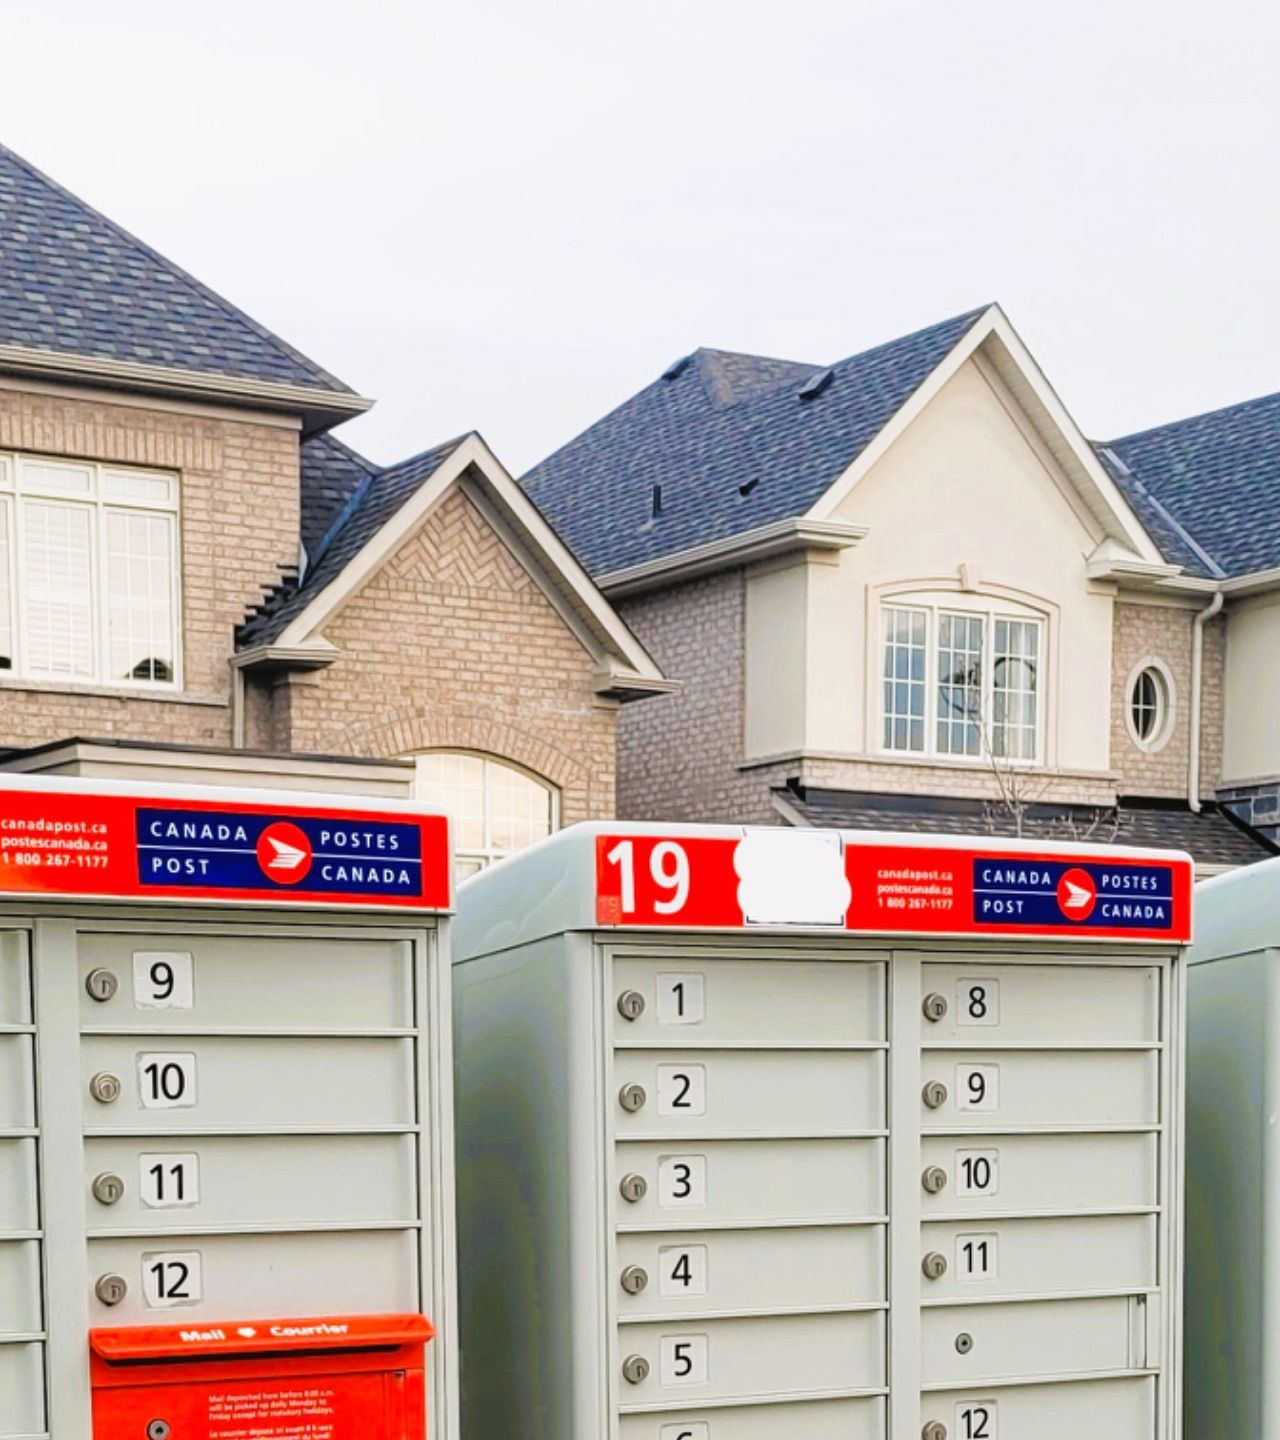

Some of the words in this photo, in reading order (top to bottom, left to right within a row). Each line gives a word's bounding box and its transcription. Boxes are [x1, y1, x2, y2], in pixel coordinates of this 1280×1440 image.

[1, 818, 108, 835] canadapost.ca
[150, 821, 248, 842] CANADA
[320, 831, 400, 850] POSTES
[1, 836, 108, 851] postescanada.ca
[15, 853, 40, 866] 800
[46, 854, 108, 868] 267-1177
[152, 858, 210, 875] POST
[321, 865, 411, 884] CANADA
[877, 869, 953, 881] canadapost.ca
[607, 840, 690, 914] 19
[877, 884, 953, 896] postescanada.ca
[982, 870, 1052, 885] CANADA
[1102, 874, 1158, 890] POSTES
[983, 900, 1024, 913] POST
[1102, 904, 1165, 919] CANADA
[151, 962, 173, 999] 9
[673, 983, 682, 1015] 1
[969, 987, 986, 1018] 8
[145, 1063, 184, 1099] 10
[673, 1074, 690, 1107] 2
[969, 1072, 984, 1103] 9
[151, 1164, 183, 1200] 11
[674, 1164, 690, 1197] 3
[962, 1158, 990, 1188] 10
[672, 1255, 691, 1286] 4
[964, 1242, 987, 1272] 11
[151, 1263, 189, 1297] 12
[180, 1329, 225, 1341] Mail
[270, 1324, 349, 1338] Courrier
[675, 1344, 691, 1376] 5
[962, 1408, 988, 1439] 12
